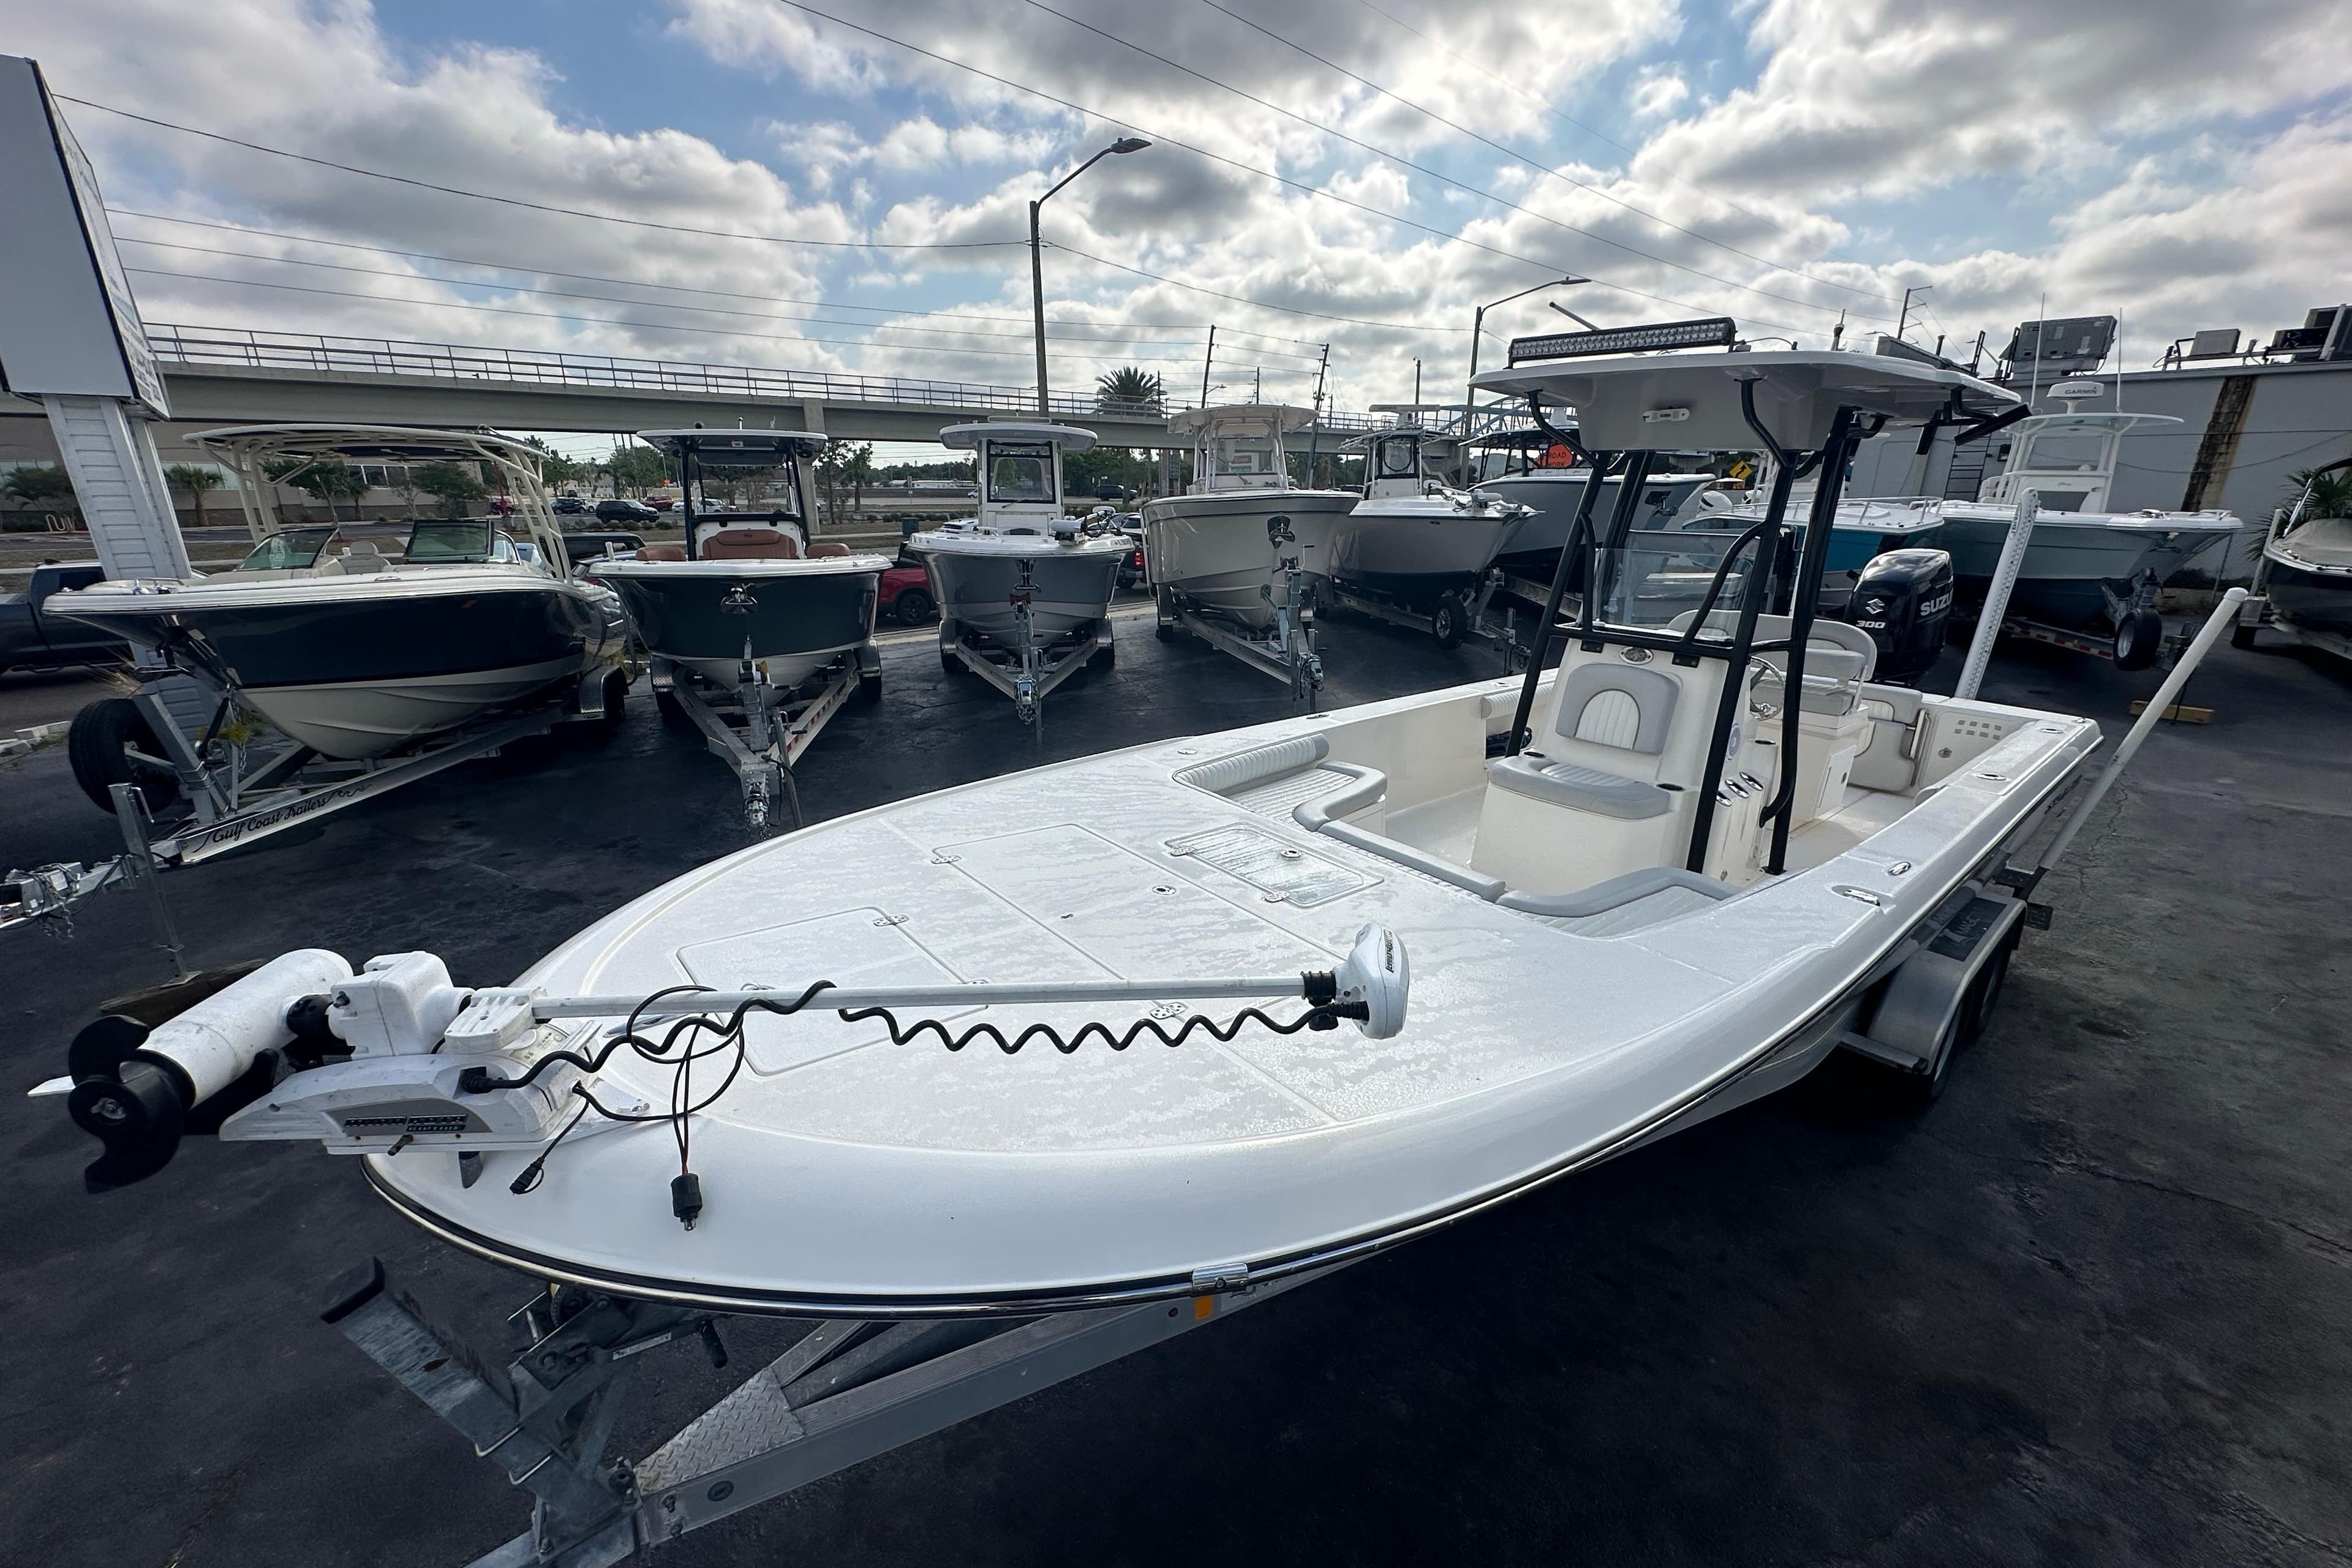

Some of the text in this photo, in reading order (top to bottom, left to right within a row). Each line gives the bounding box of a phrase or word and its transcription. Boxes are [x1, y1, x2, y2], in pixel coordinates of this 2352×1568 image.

[212, 796, 326, 842] Gulf Coast Trailers
